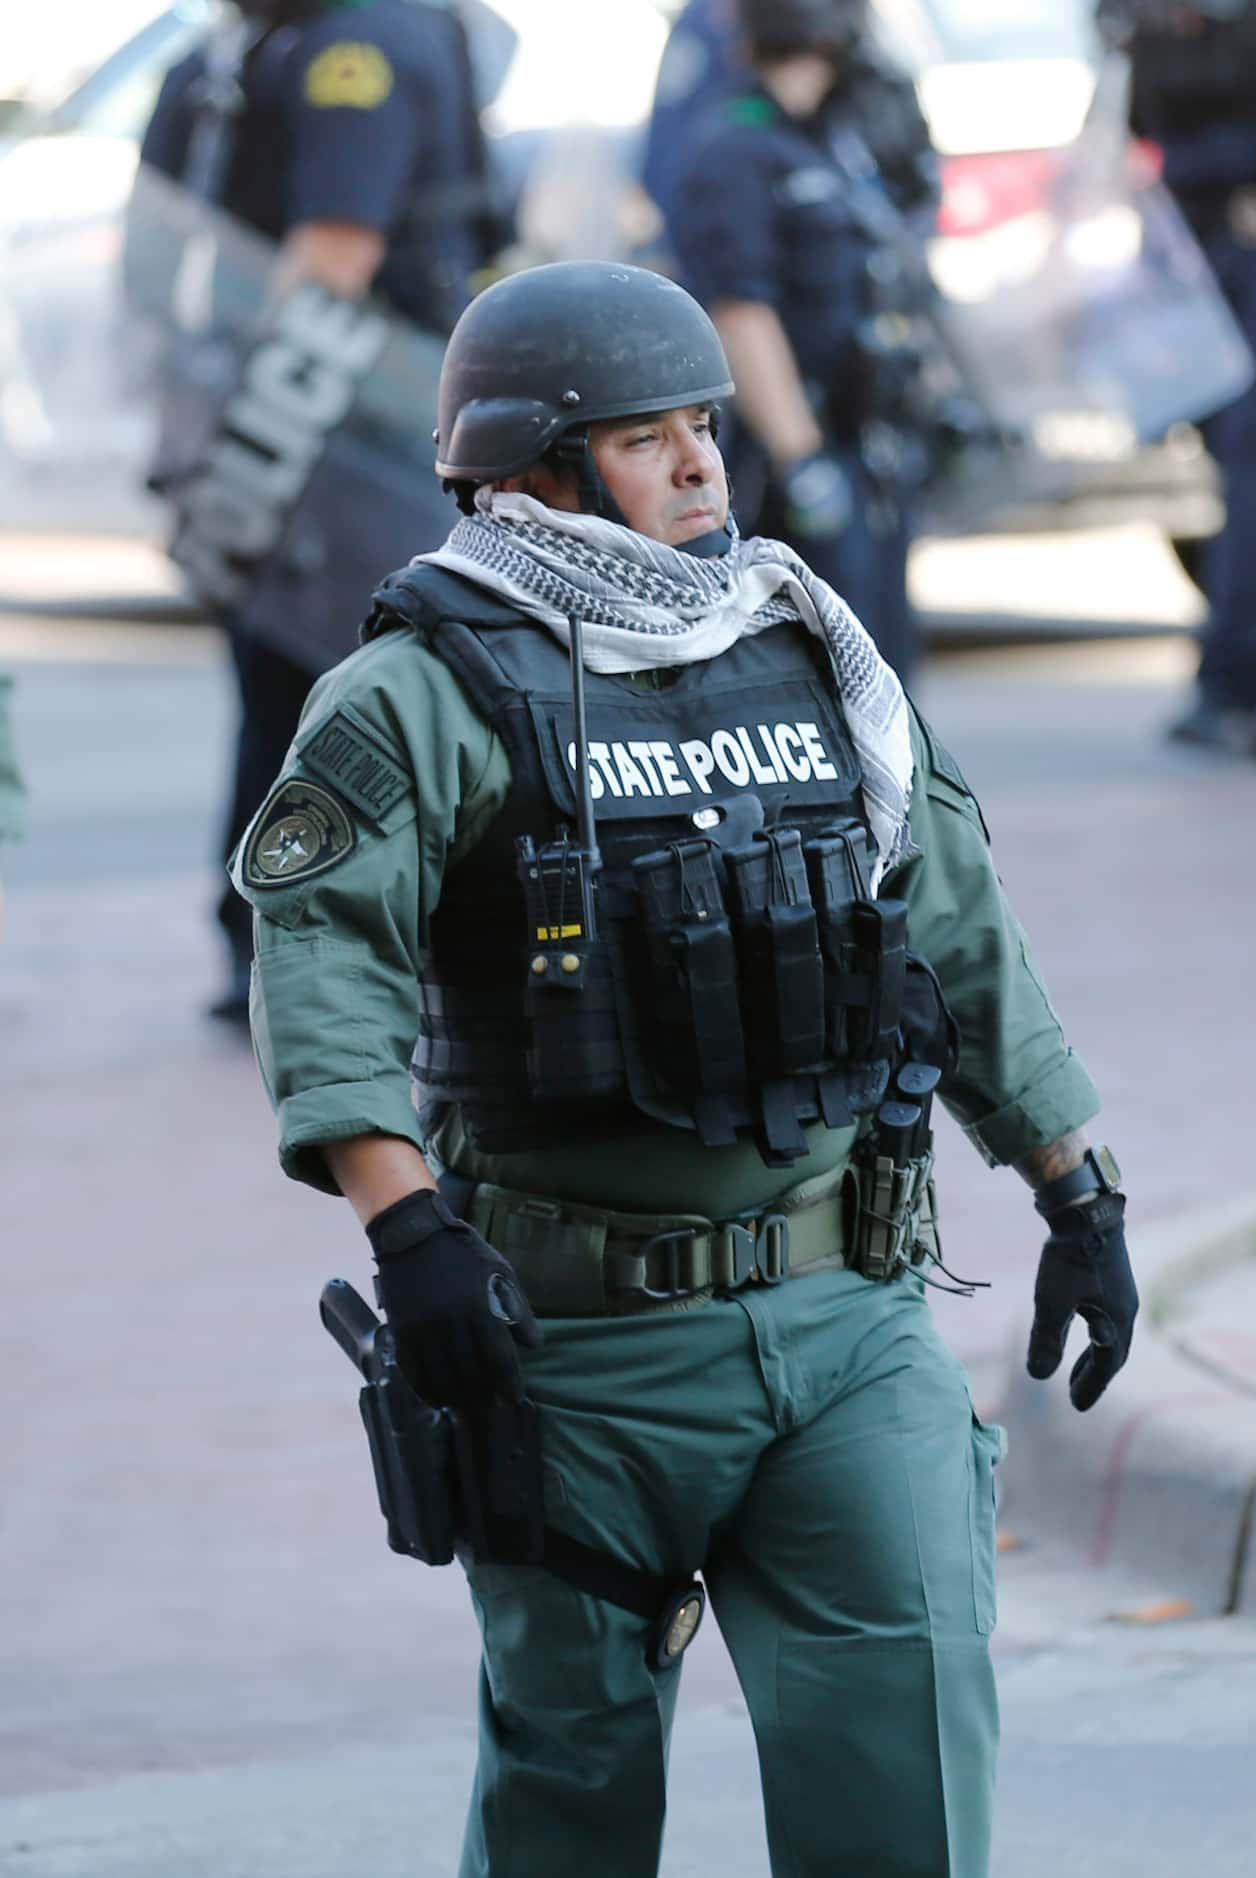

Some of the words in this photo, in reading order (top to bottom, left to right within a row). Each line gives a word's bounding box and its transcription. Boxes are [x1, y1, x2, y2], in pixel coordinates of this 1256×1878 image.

[312, 726, 362, 776] STATE
[344, 752, 406, 810] POLICE
[678, 722, 838, 794] POLICE
